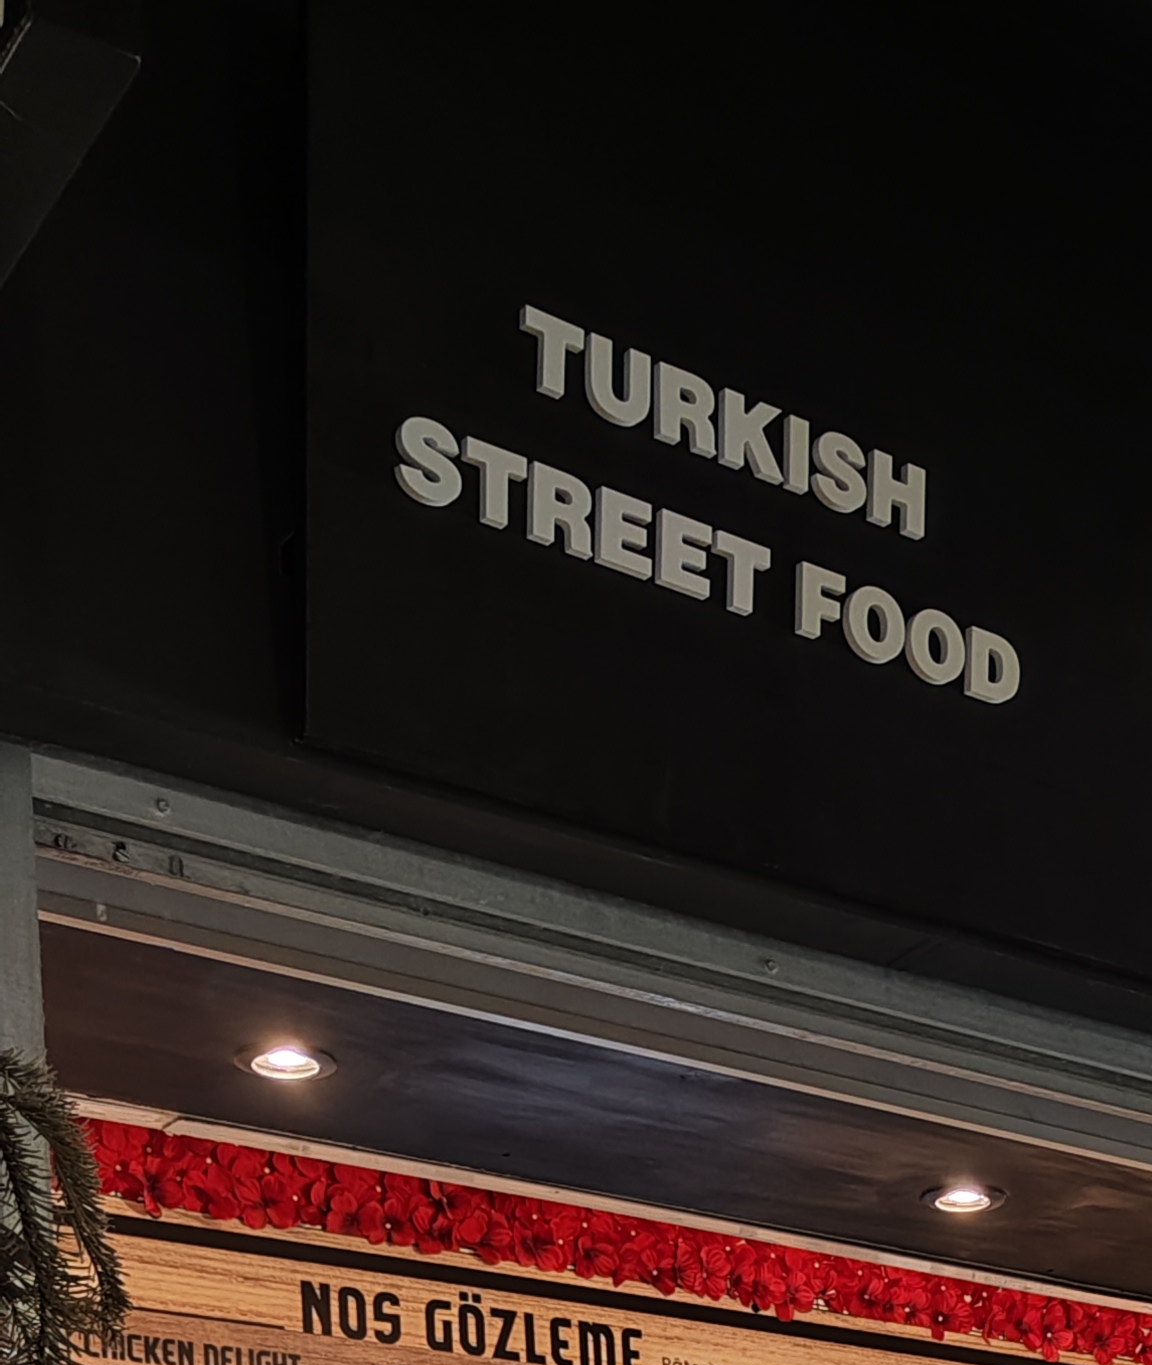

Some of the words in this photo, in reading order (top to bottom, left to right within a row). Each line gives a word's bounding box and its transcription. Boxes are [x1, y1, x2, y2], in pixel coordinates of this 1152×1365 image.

[519, 304, 926, 541] TURKISH
[394, 416, 771, 617] STREET
[795, 560, 1021, 704] FOOD
[300, 1280, 401, 1344] NOS
